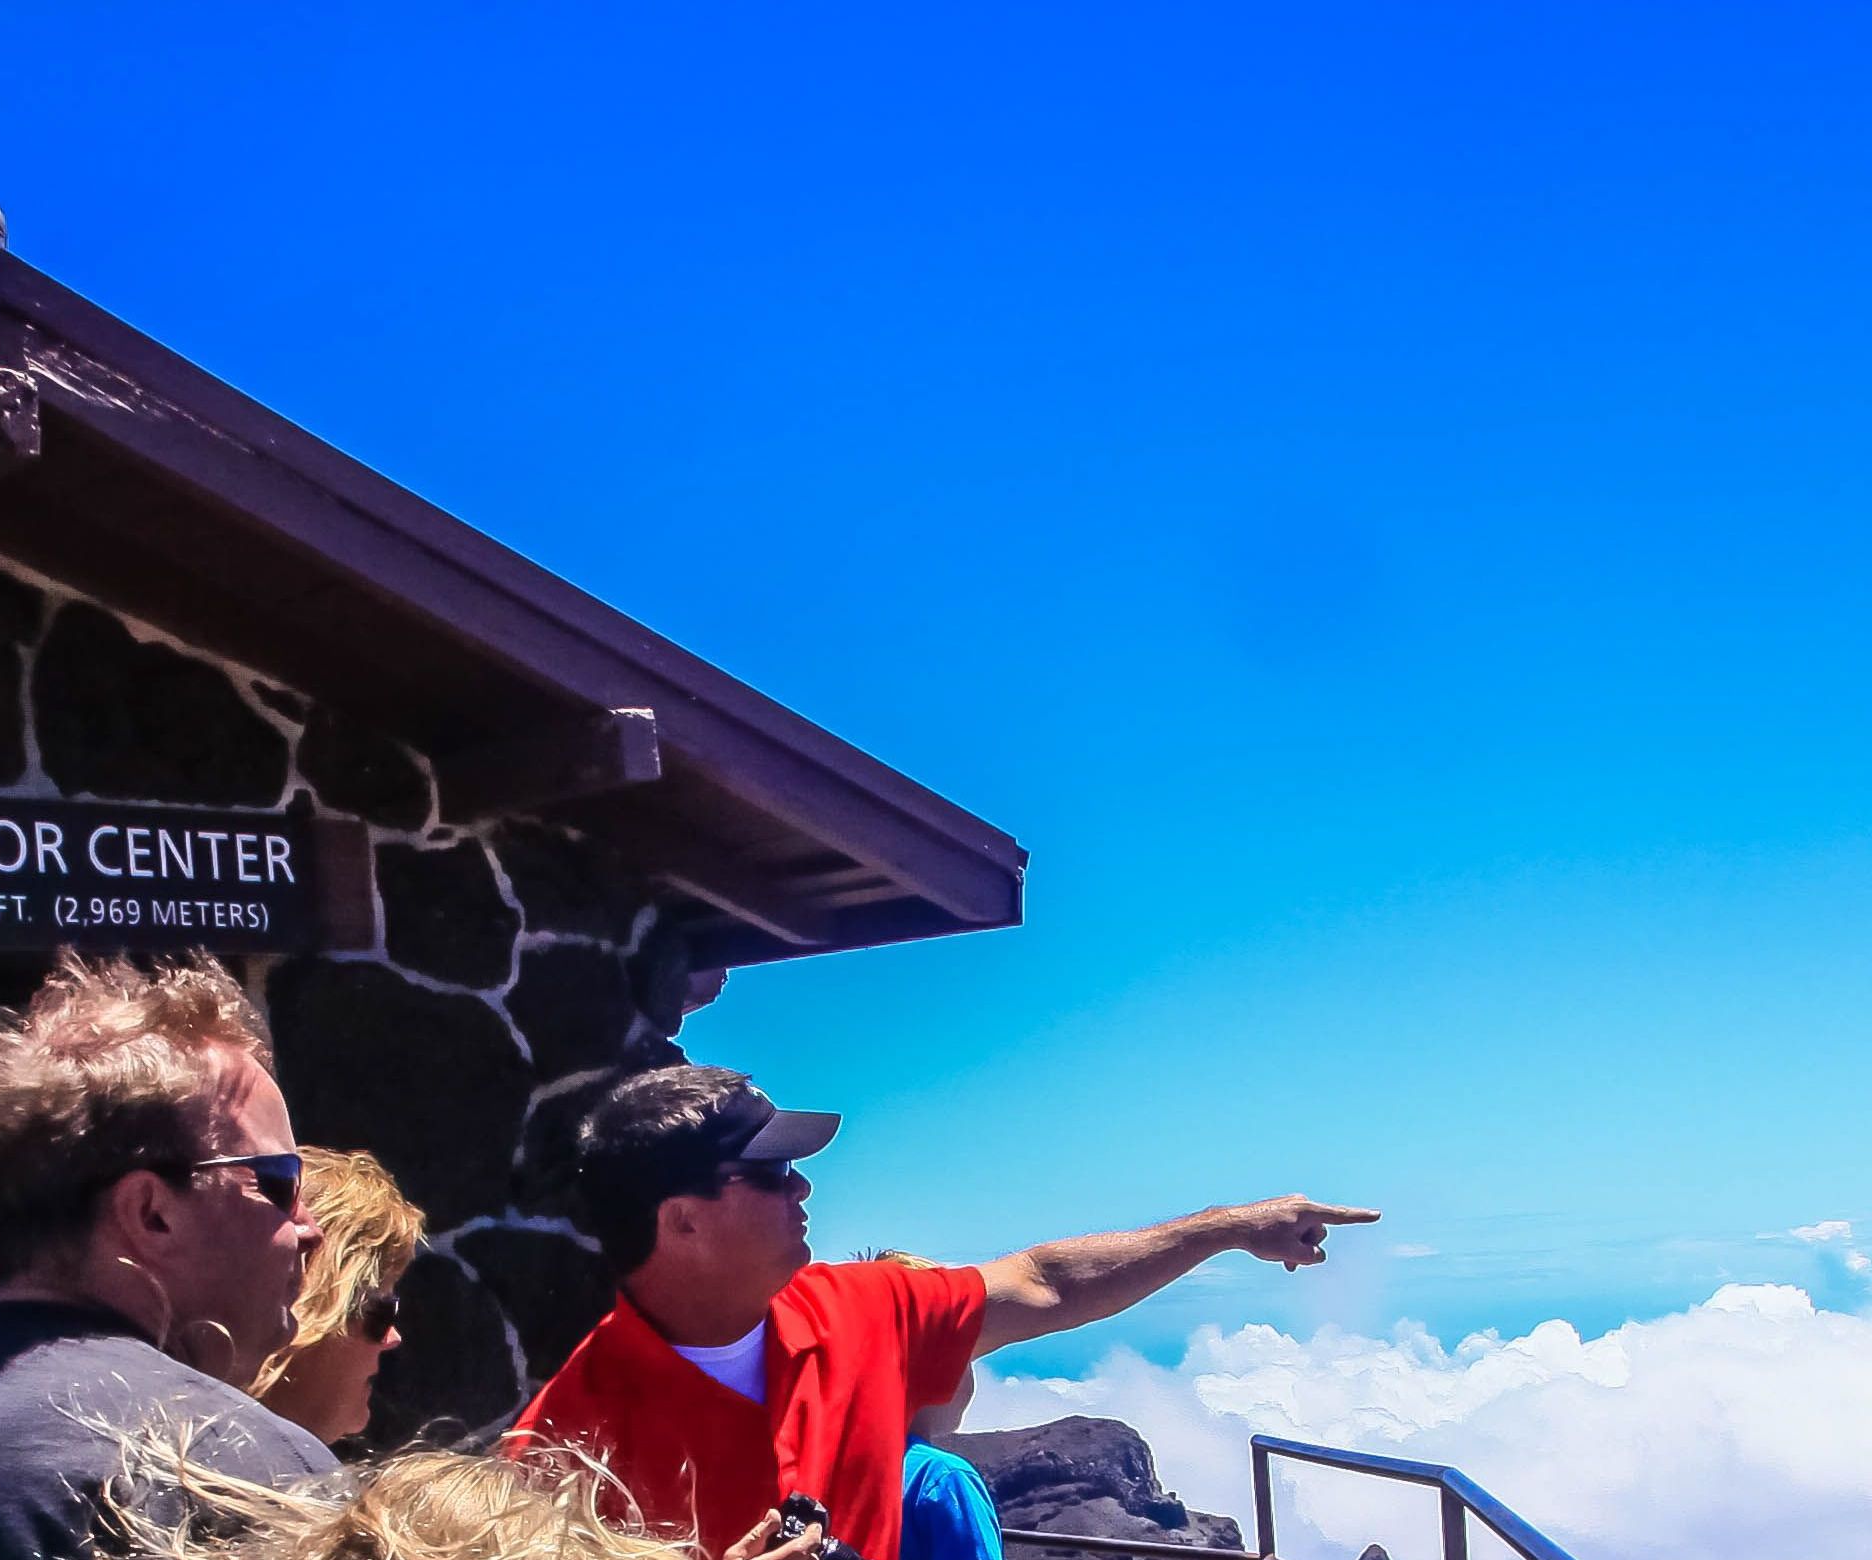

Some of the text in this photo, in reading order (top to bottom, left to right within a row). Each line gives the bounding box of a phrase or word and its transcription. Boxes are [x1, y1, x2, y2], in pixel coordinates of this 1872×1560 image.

[88, 825, 295, 884] CENTER
[54, 895, 141, 927] (2,969
[151, 900, 269, 932] METERS)
